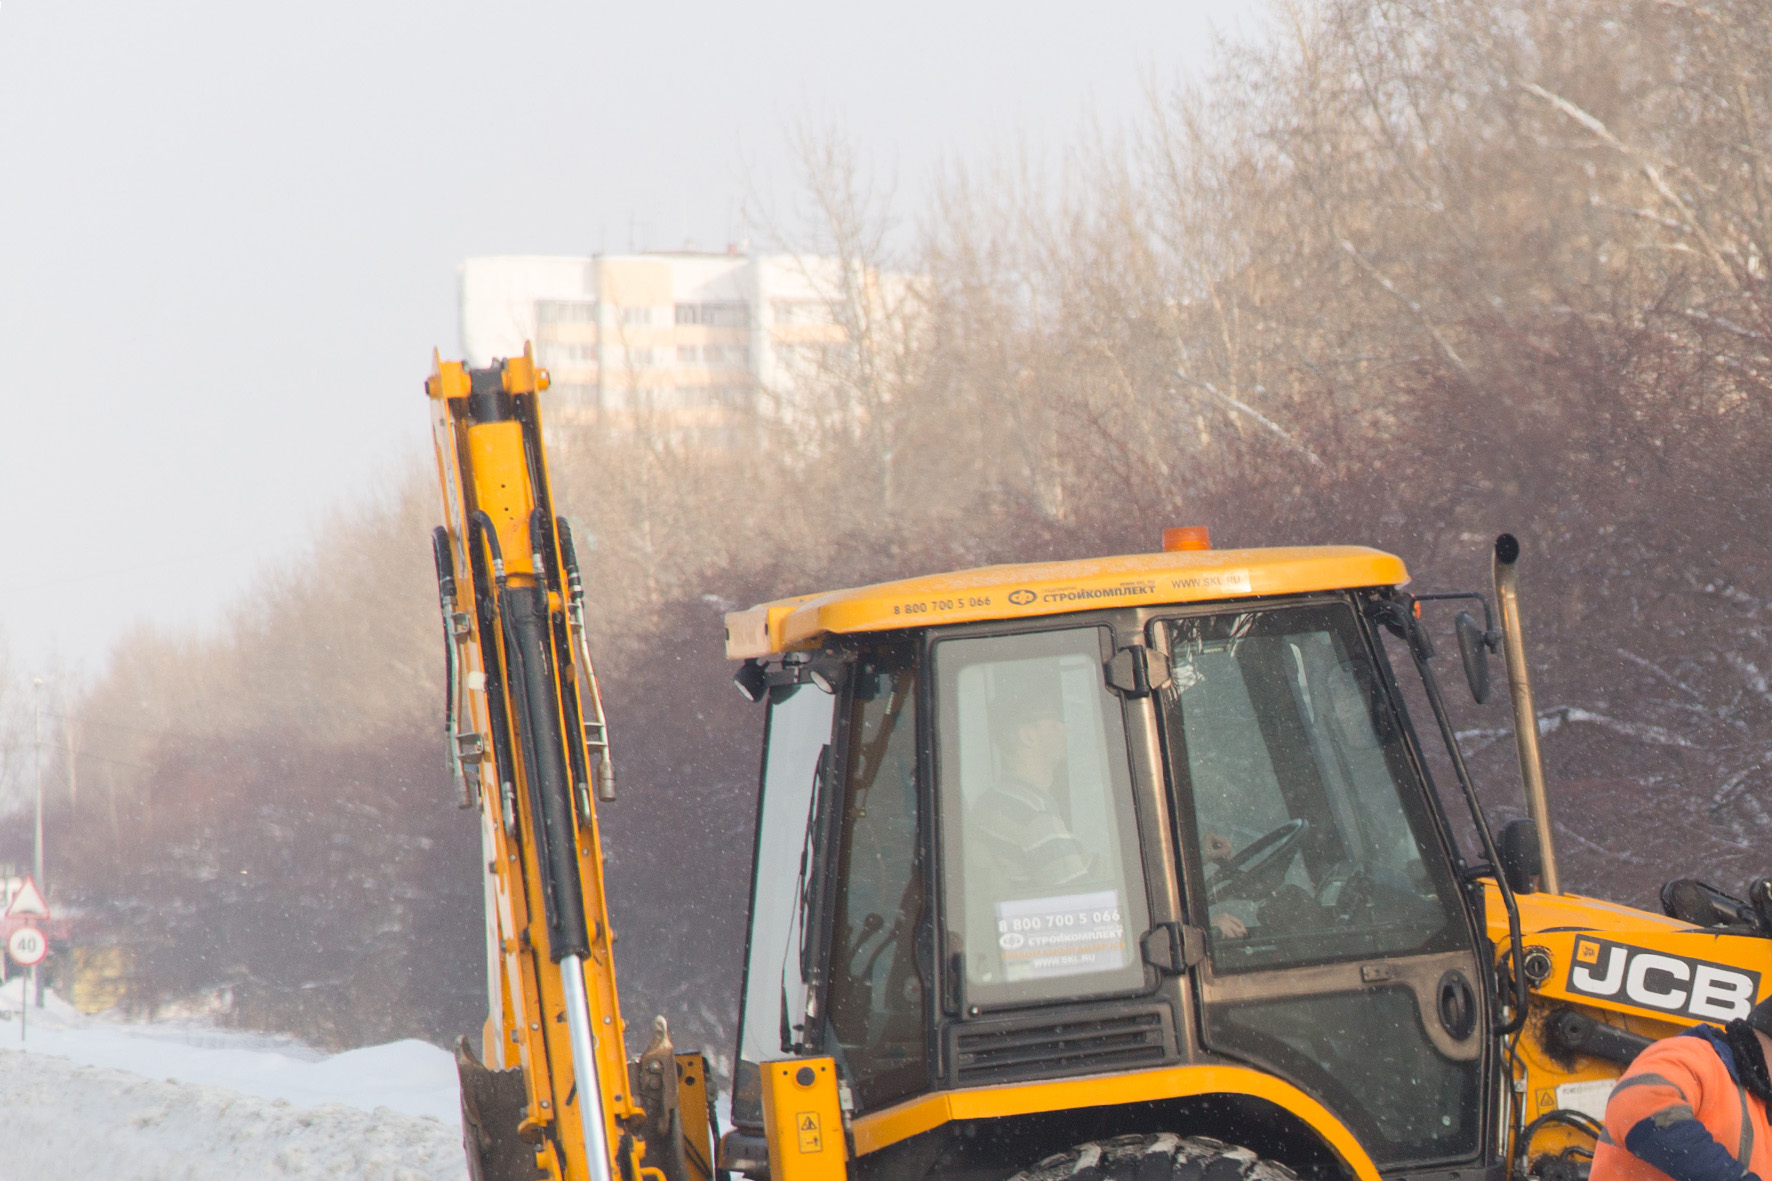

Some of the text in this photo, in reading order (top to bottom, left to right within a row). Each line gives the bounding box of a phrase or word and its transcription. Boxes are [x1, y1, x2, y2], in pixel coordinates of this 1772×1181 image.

[1043, 585, 1156, 603] СТРОЙКОМПЛЕКТ
[894, 595, 991, 615] 8 800 700 5 066
[999, 909, 1120, 932] 8 800 700 5 066
[17, 937, 36, 953] 40
[1572, 946, 1754, 1023] JCB
